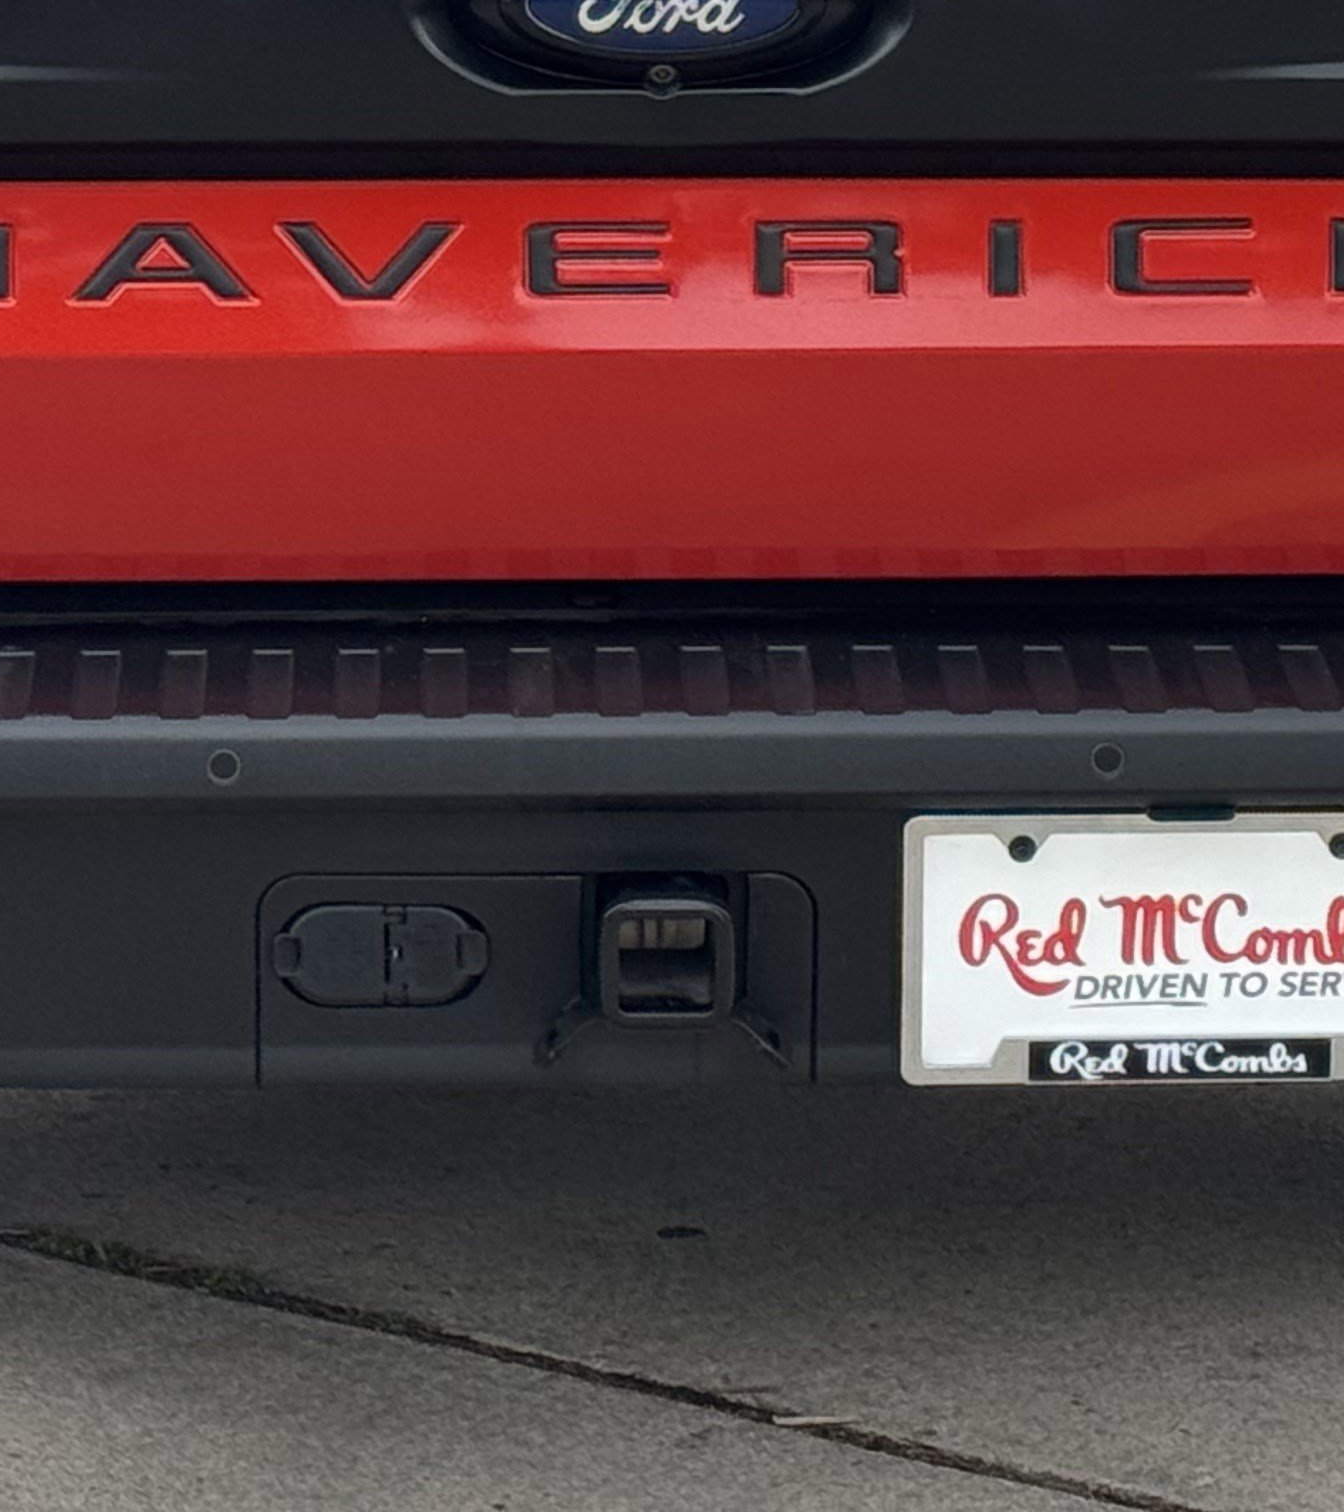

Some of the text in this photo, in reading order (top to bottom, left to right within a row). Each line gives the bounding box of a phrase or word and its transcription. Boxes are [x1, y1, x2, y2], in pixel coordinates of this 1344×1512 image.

[958, 893, 1088, 997] Red
[1074, 972, 1209, 1001] DRIVEN
[1221, 972, 1268, 999] TO
[1050, 1041, 1129, 1081] Red
